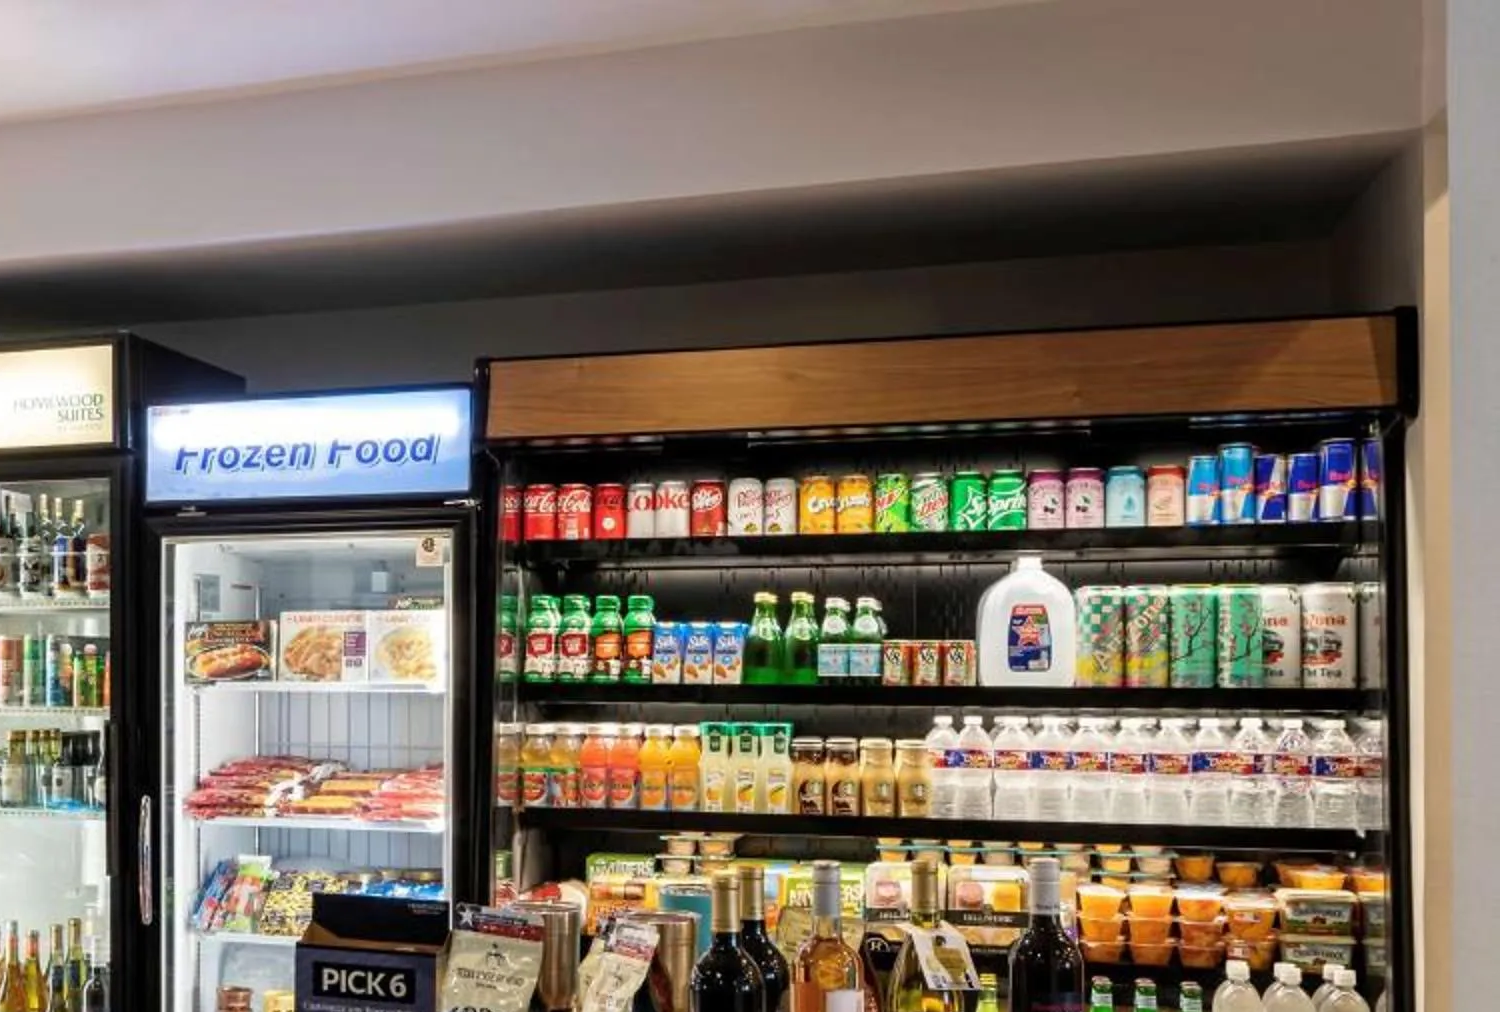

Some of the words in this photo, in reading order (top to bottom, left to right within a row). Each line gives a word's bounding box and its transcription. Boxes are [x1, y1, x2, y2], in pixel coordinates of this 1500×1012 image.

[57, 407, 104, 422] SUITES
[175, 443, 315, 472] Frozen
[327, 434, 440, 465] Food
[322, 967, 386, 997] PICK
[389, 973, 407, 998] 6
